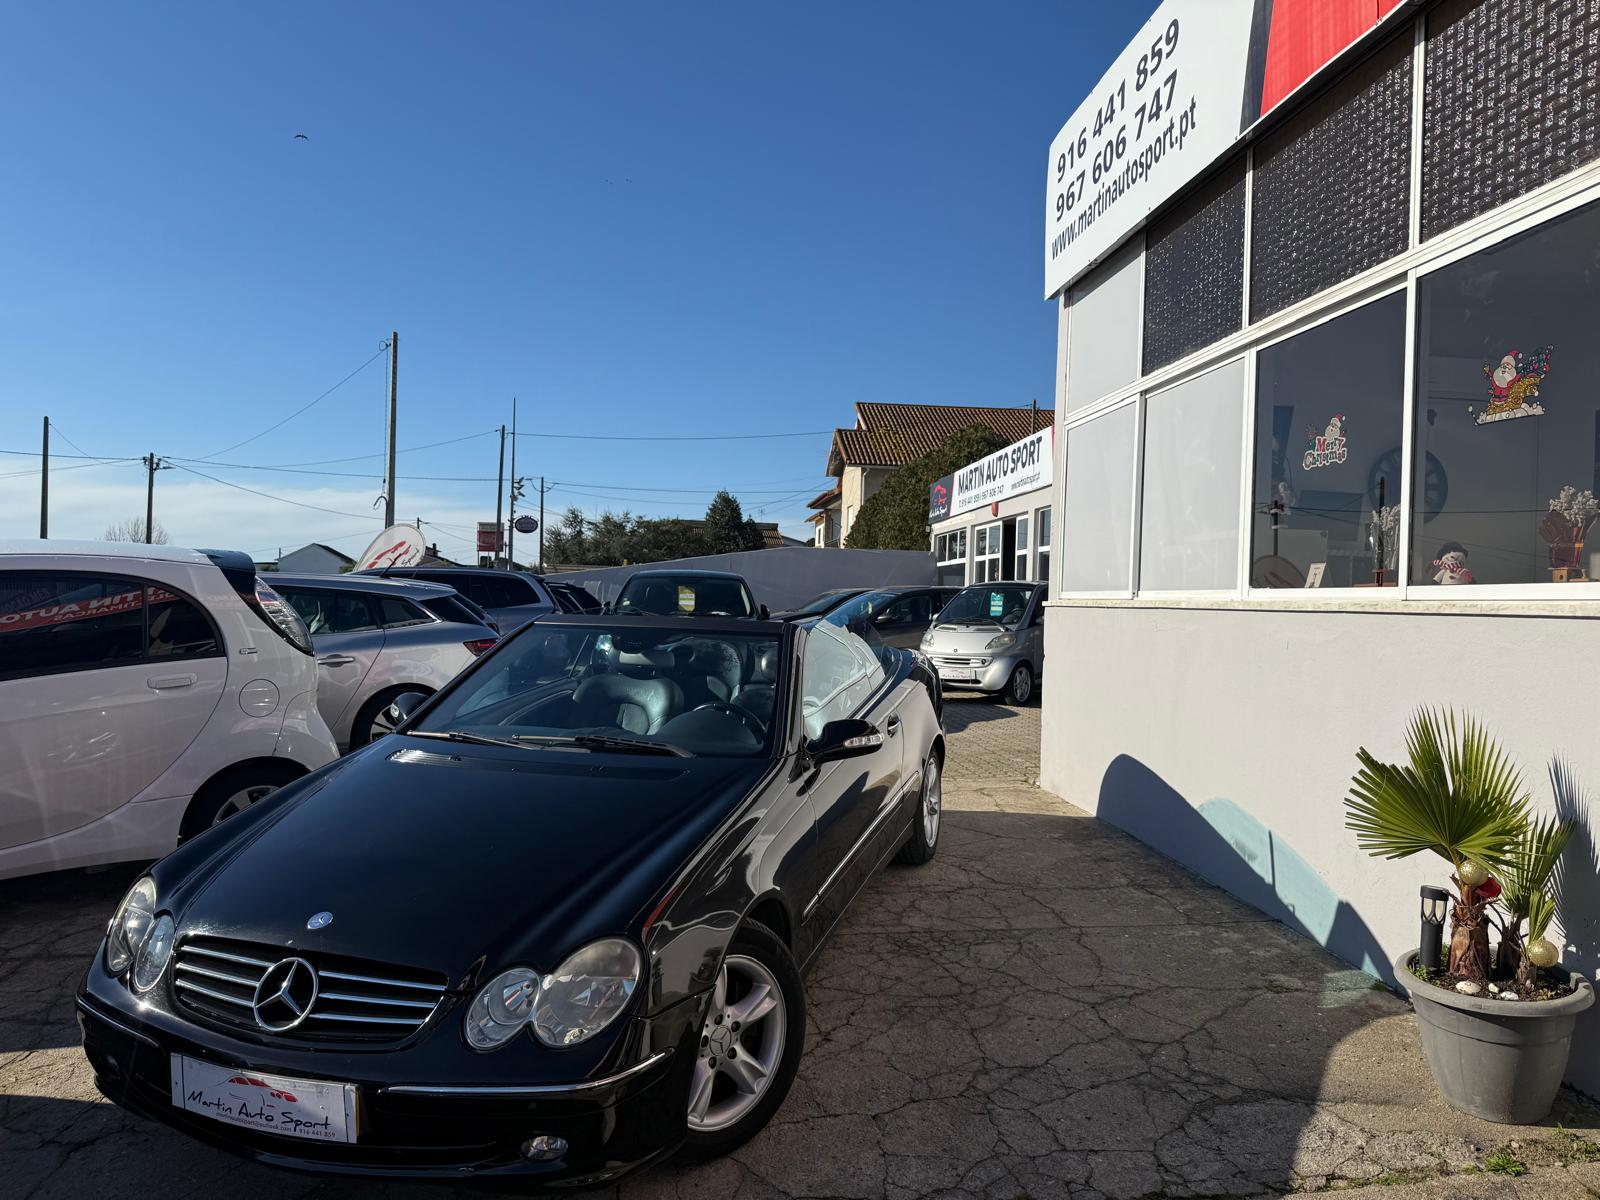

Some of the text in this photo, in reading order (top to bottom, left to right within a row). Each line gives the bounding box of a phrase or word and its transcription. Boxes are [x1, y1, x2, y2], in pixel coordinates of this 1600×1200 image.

[1057, 18, 1179, 184] 916 441 859
[1056, 68, 1178, 222] 967 606 747
[1051, 95, 1197, 261] www.martinautosport.pt
[957, 436, 1043, 497] MARTIN AUTO SPORT
[1303, 449, 1347, 469] Christmas
[1316, 437, 1345, 452] Merry
[187, 1090, 330, 1133] Martin Auto Sport
[299, 1127, 310, 1136] 916
[311, 1129, 322, 1137] 441
